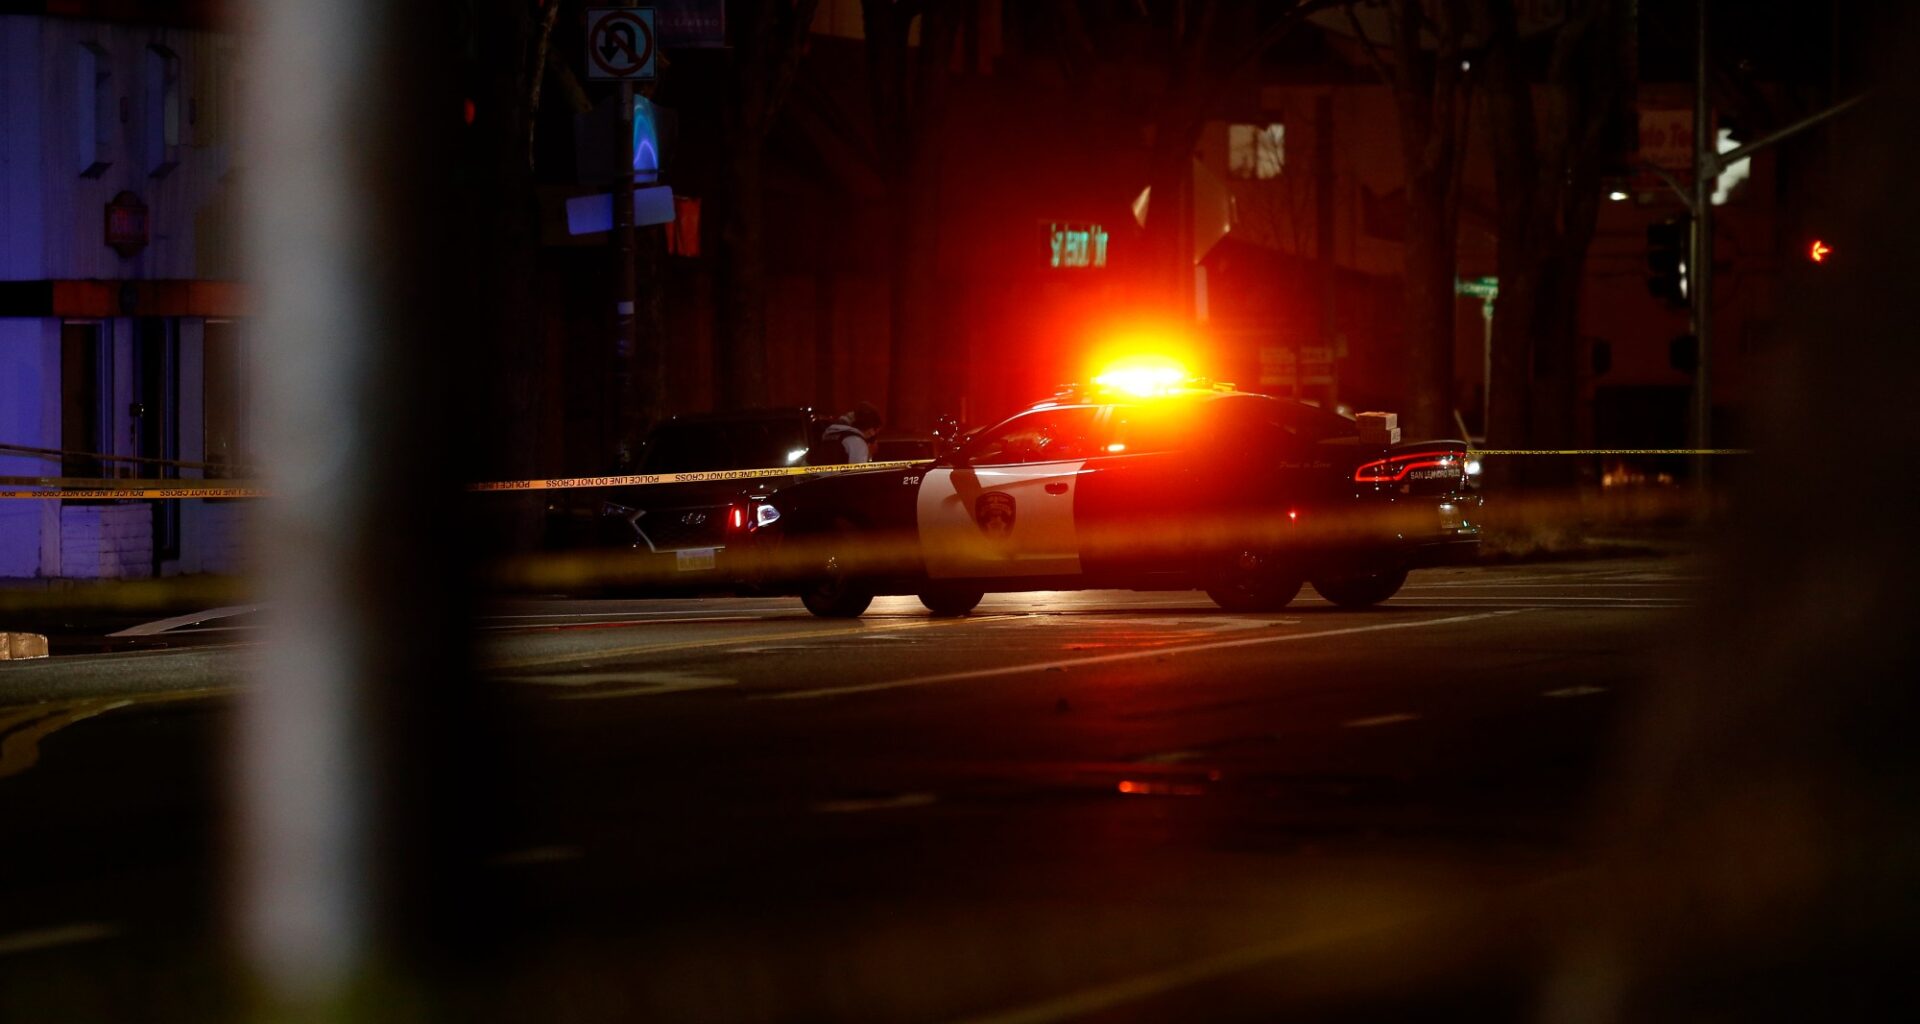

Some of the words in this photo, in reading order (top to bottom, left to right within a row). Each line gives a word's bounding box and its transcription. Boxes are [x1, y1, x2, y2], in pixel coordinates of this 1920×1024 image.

[707, 473, 724, 481] NOT
[758, 469, 789, 477] POLICE
[1410, 471, 1424, 480] SAN
[595, 478, 608, 486] DO
[610, 477, 628, 485] LINE
[629, 475, 660, 484] POLICE
[675, 474, 704, 482] CROSS
[903, 476, 920, 485] 212
[502, 481, 530, 489] POLICE
[546, 479, 575, 488] CROSS
[577, 478, 594, 487] NOT
[160, 489, 188, 497] CROSS
